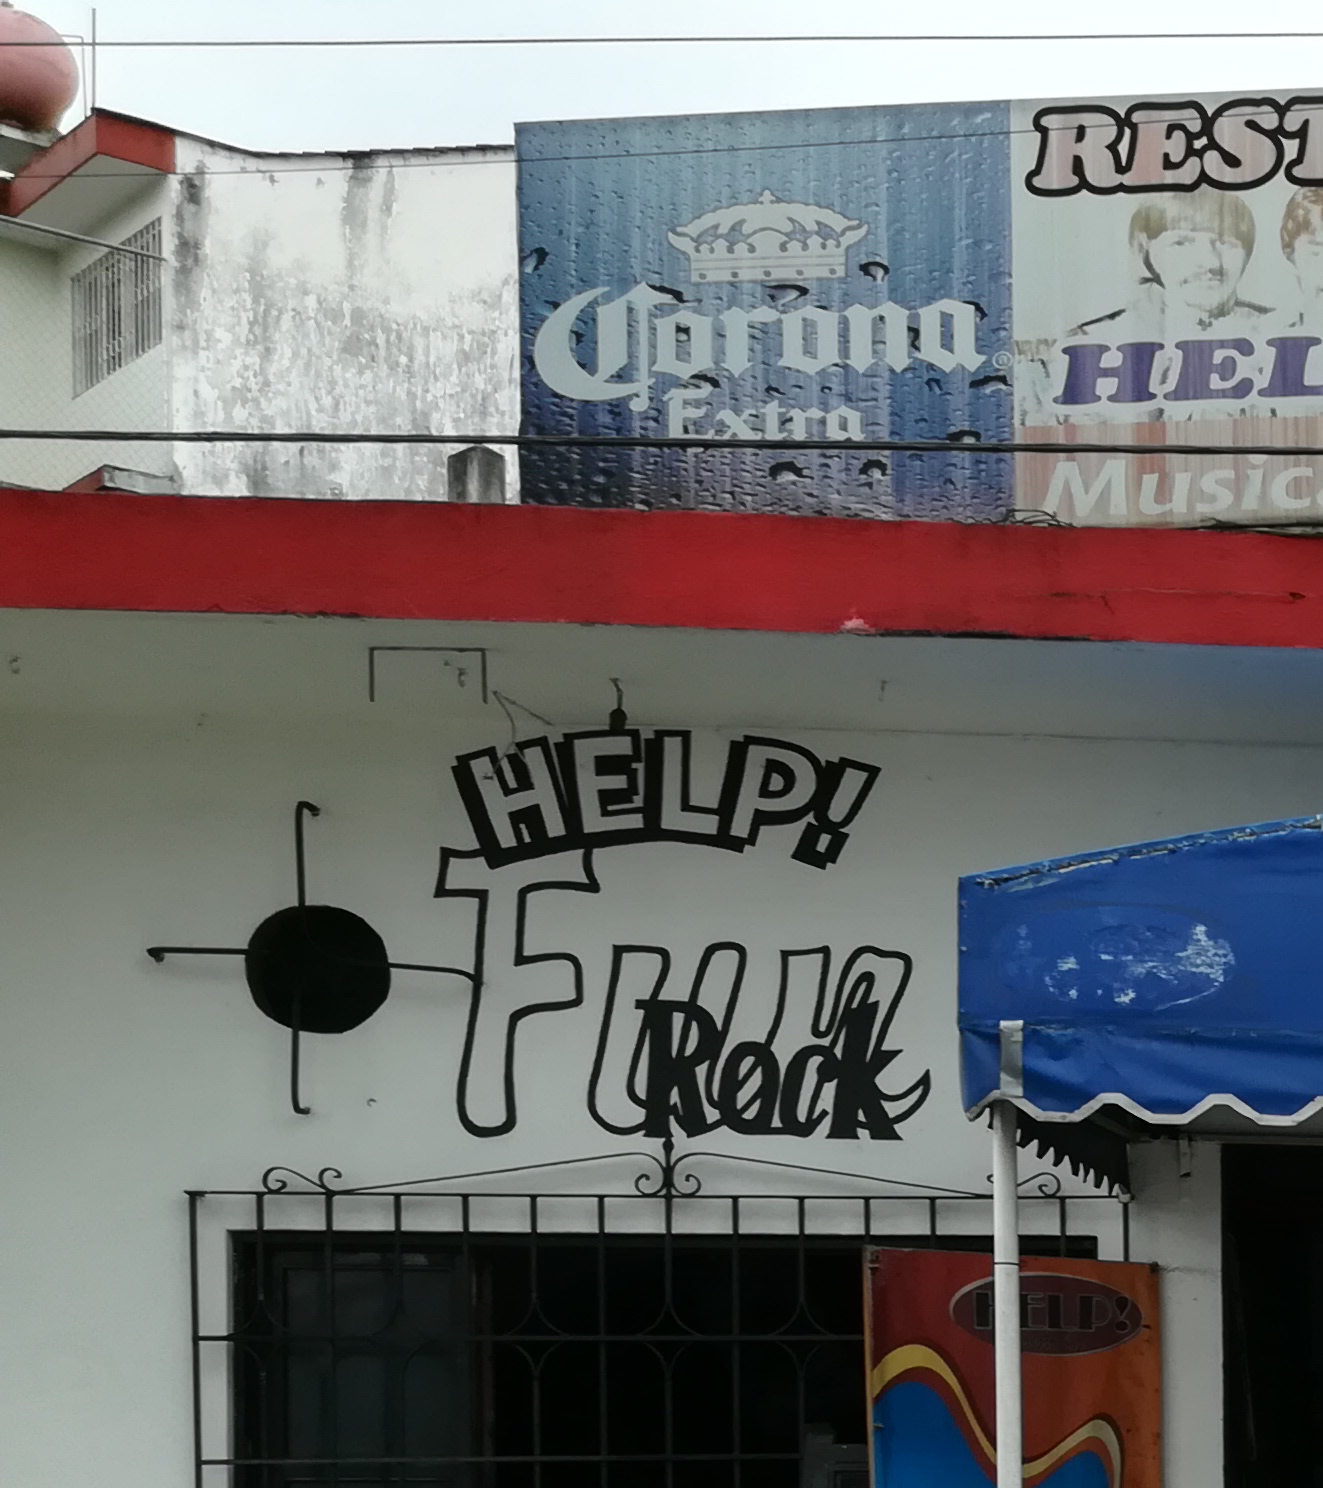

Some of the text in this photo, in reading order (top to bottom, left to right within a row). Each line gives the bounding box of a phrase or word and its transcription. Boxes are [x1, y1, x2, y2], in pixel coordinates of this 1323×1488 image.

[533, 281, 988, 413] Corona
[664, 394, 866, 442] Extra
[451, 729, 881, 869] HELP!
[433, 846, 931, 1138] Fun
[634, 970, 904, 1140] Rock
